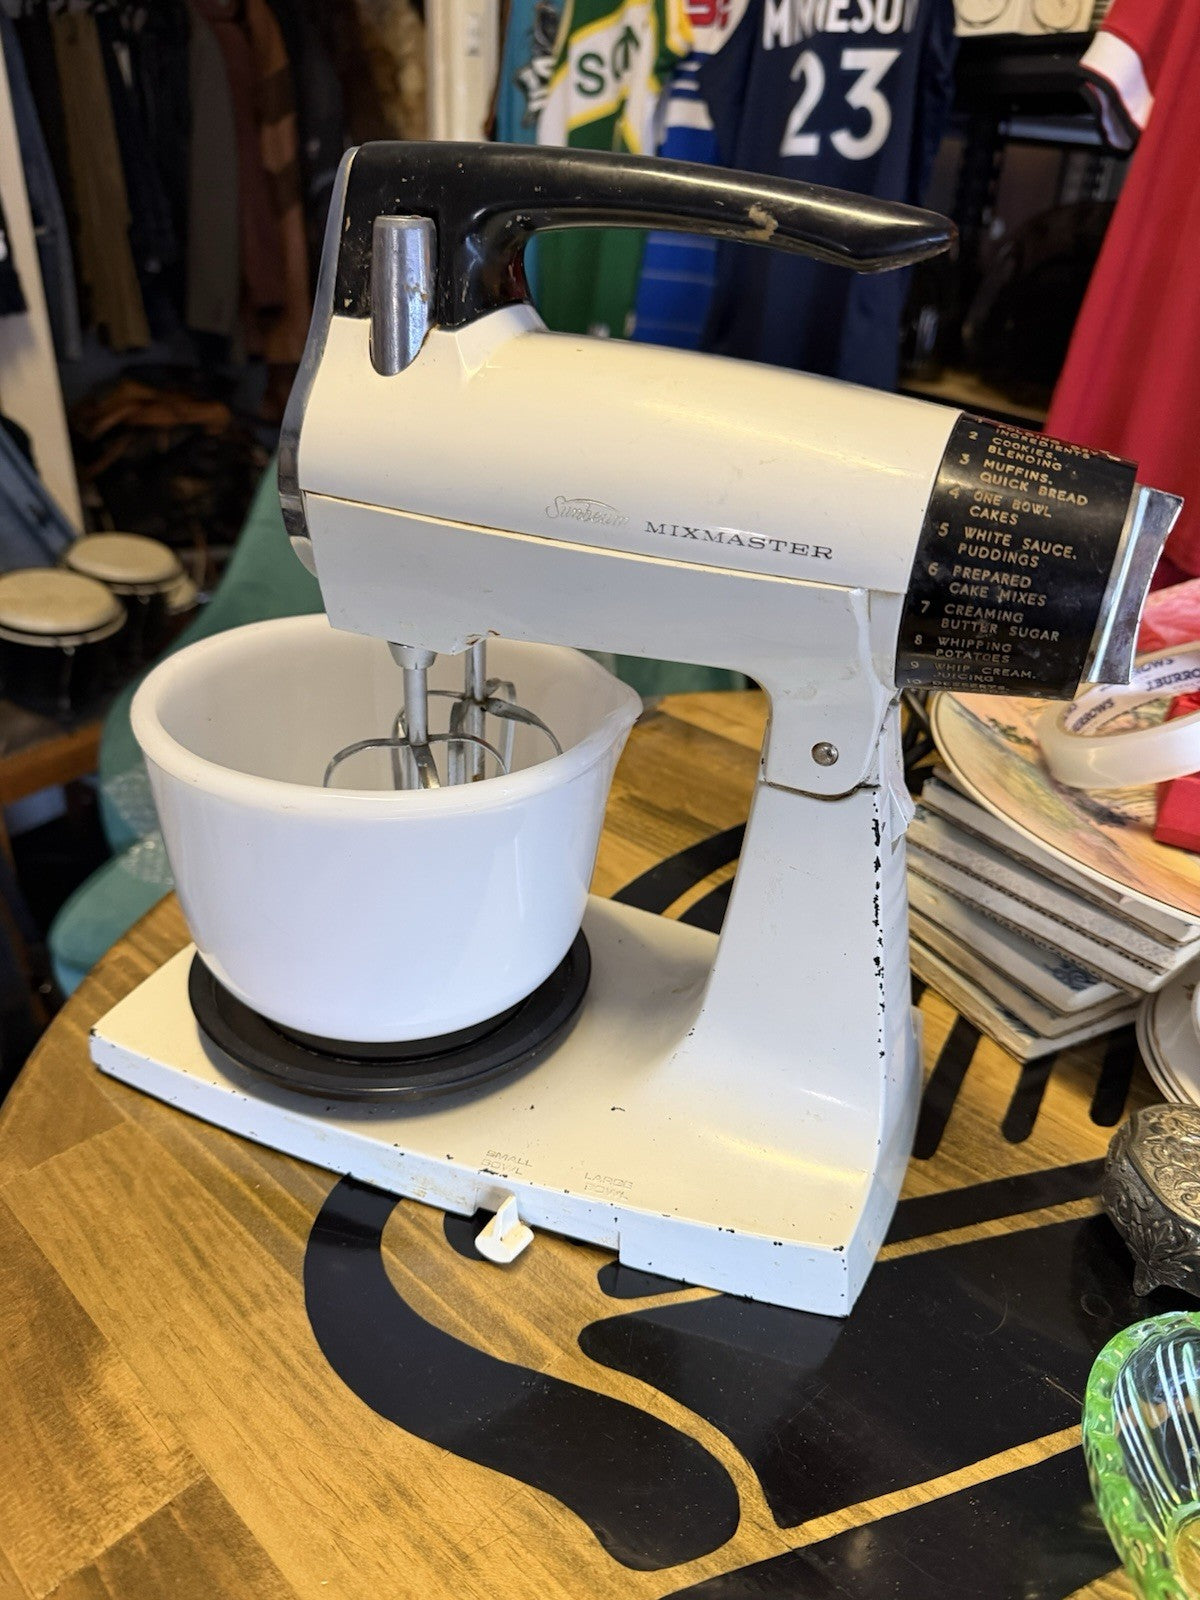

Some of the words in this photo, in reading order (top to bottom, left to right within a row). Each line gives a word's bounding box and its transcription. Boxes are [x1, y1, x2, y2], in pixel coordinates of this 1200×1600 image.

[780, 49, 901, 160] 23
[968, 431, 979, 440] 2
[995, 428, 1091, 460] INGREDIENTS
[959, 453, 970, 465] 3
[987, 445, 1062, 471] BLENDING
[980, 471, 1030, 492] QUICK
[1037, 486, 1089, 506] BREAD
[949, 485, 961, 499] 4
[973, 490, 1003, 507] ONE
[1011, 500, 1052, 518] BOWL
[969, 506, 1019, 526] CAKES
[644, 520, 833, 560] MIXMASTER
[937, 522, 949, 537] 5
[964, 526, 1012, 547] WHITE
[957, 542, 1040, 568] PUDDINGS
[928, 562, 939, 576] 6
[952, 565, 1032, 588] PREPARED
[949, 582, 990, 599] CAKE
[999, 590, 1047, 607] MIXES
[920, 600, 931, 613] 7
[944, 603, 1024, 623] CREAMING
[941, 617, 998, 634] BUTTER
[1009, 626, 1060, 642] SUGAR
[914, 634, 923, 645] 8
[938, 636, 1012, 653] WHIPPING
[935, 648, 1010, 663] POTATOES
[910, 661, 919, 670] 9
[934, 662, 970, 672] WHIP
[486, 1150, 533, 1168] SMALL
